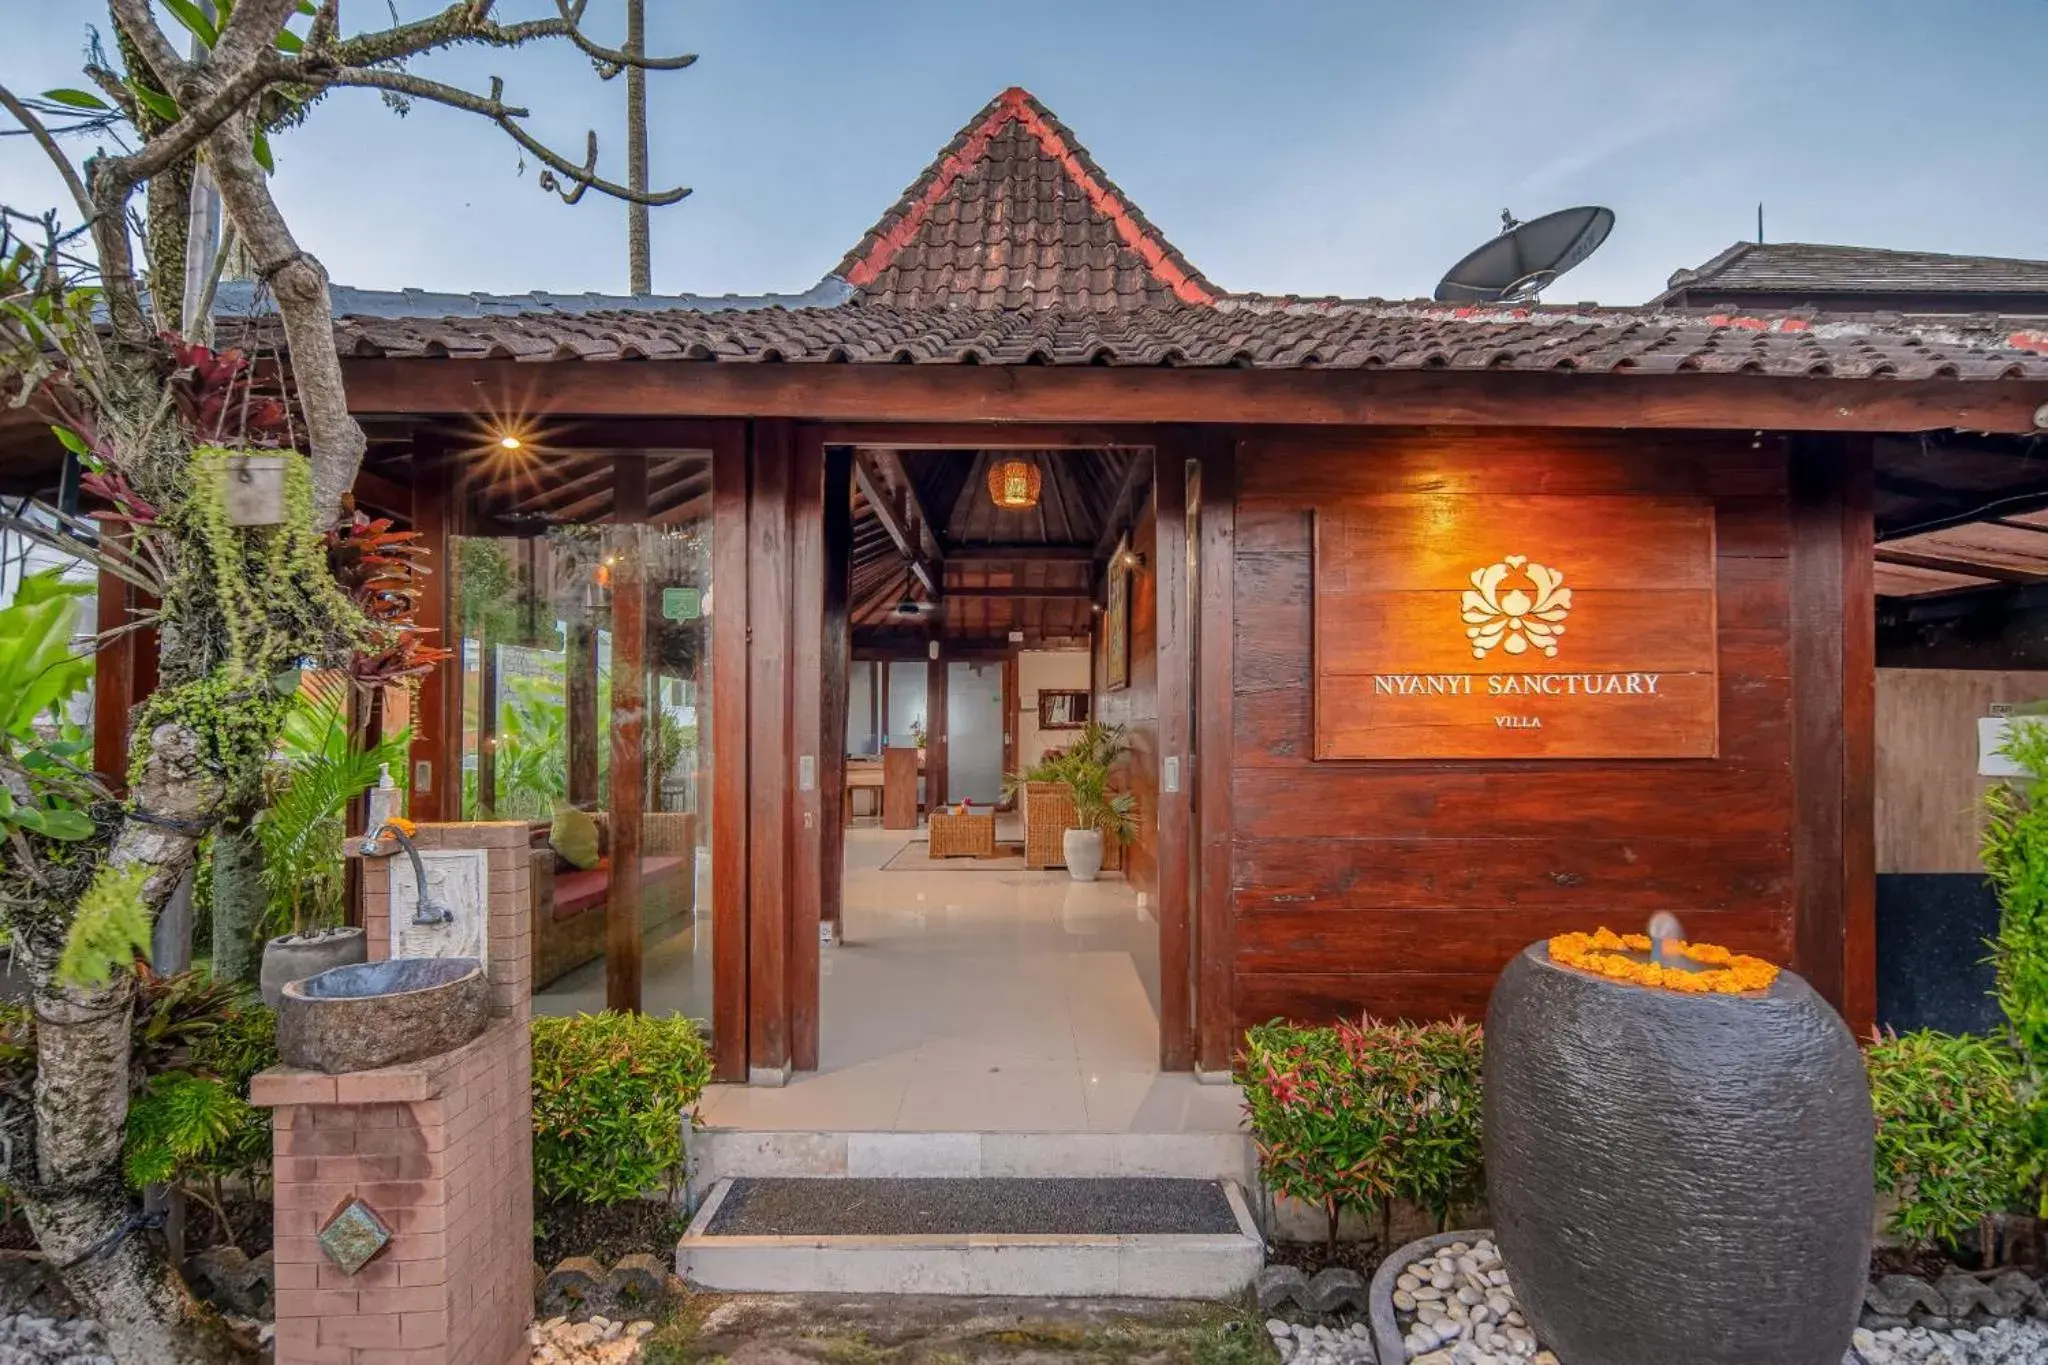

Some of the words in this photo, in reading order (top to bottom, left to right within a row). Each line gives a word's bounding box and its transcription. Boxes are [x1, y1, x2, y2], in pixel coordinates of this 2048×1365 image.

[1374, 674, 1471, 695] NYANYI
[1487, 674, 1659, 695] SANCTUARY
[1494, 715, 1541, 729] VILLA
